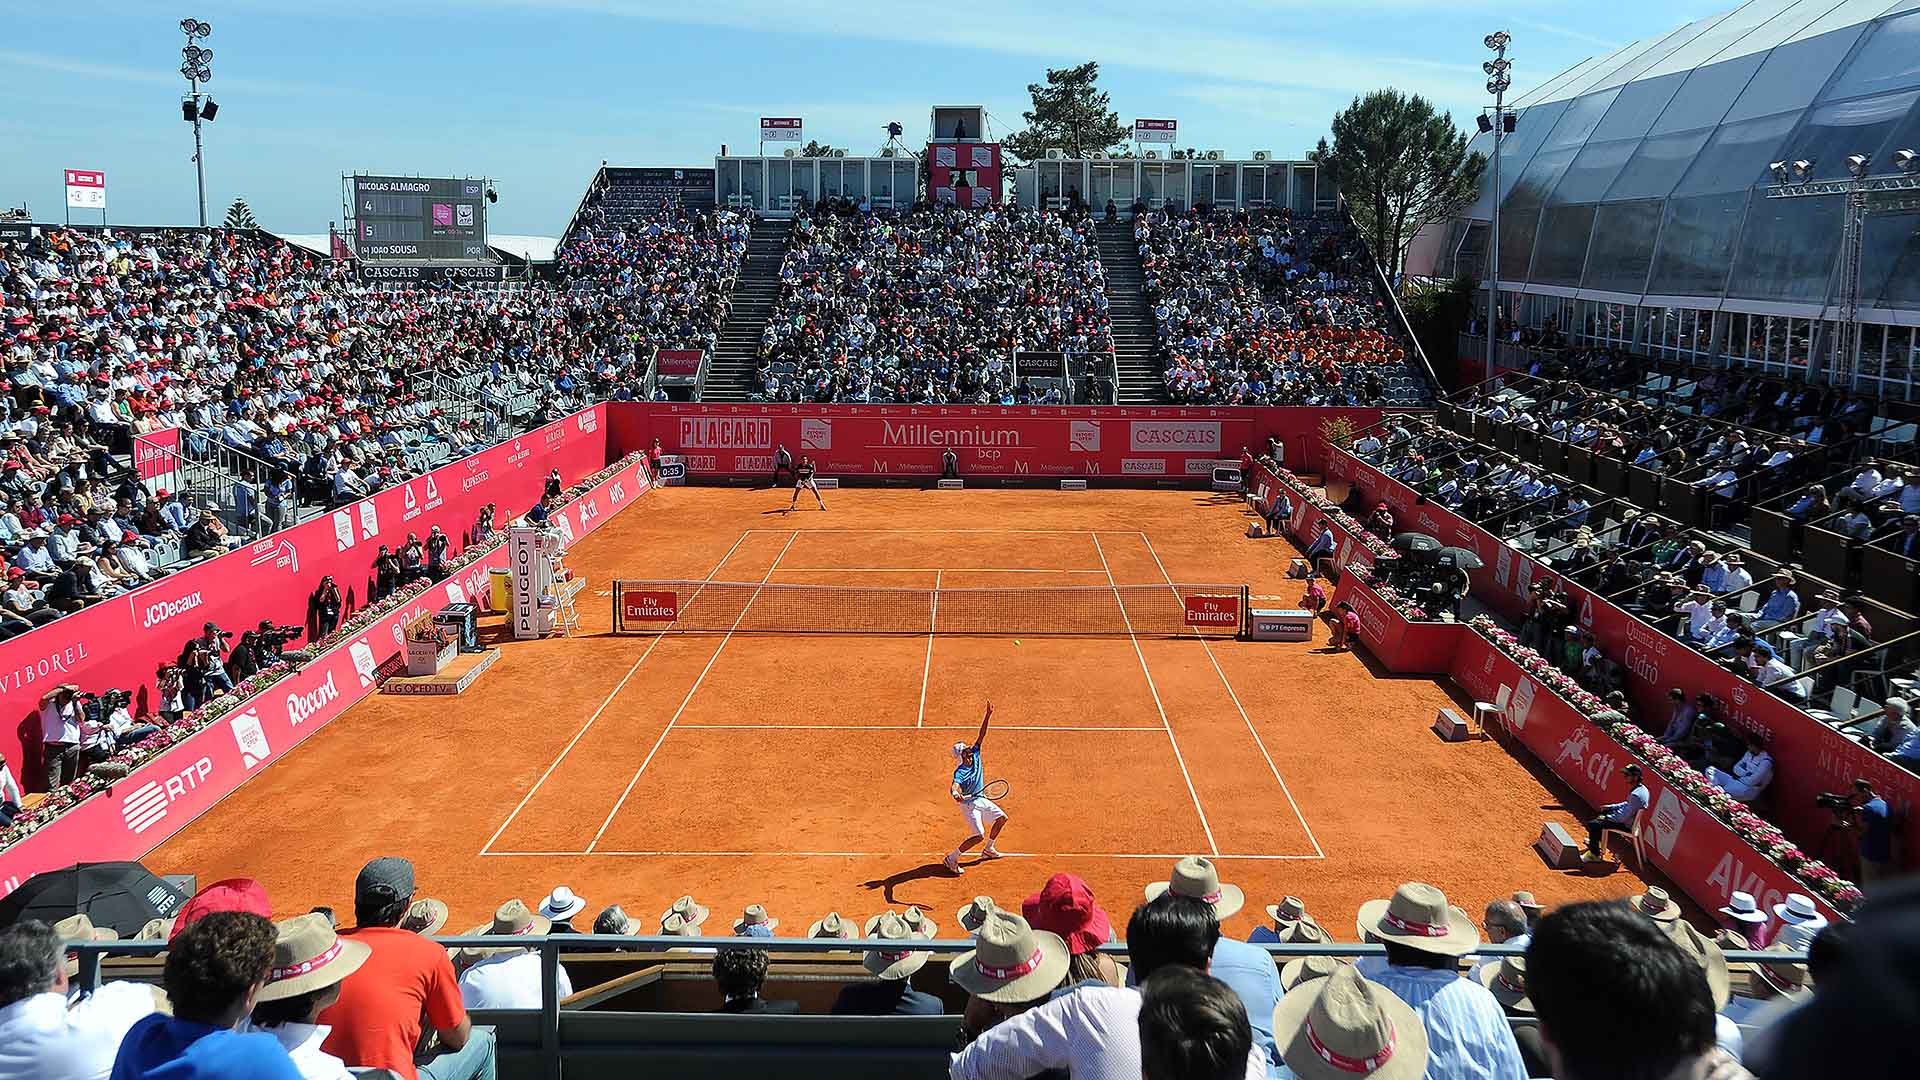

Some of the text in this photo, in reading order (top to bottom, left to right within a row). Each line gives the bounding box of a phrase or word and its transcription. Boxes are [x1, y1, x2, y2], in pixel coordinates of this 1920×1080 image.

[358, 182, 430, 192] NICOLAS ALMAGRO
[466, 186, 479, 194] ESP
[365, 200, 372, 211] 4
[366, 226, 373, 236] 5
[390, 245, 418, 254] SOUSA
[364, 267, 420, 278] CASCAIS
[445, 267, 496, 277] CASCAIS
[1018, 359, 1059, 367] CASCAIS
[680, 417, 772, 448] PLACARD
[881, 418, 1020, 446] Millennium
[1135, 429, 1216, 444] CASCAIS
[977, 447, 1001, 461] bcp
[735, 455, 776, 471] PLACAR
[1123, 461, 1164, 471] CASCAIS
[662, 466, 680, 477] 0:35
[608, 481, 625, 505] AVIS
[517, 536, 531, 632] PEUGEOT
[643, 597, 658, 607] Fly
[1204, 602, 1218, 612] Fly
[143, 591, 204, 629] JCDecaux
[627, 605, 674, 617] Emirates
[1187, 610, 1235, 622] Emirates
[1625, 619, 1668, 657] Quinta de
[0, 641, 89, 695] VIBOREL
[1624, 645, 1659, 686] Cidrô
[388, 684, 401, 693] LG
[433, 684, 447, 693] TV
[286, 669, 339, 728] Record
[165, 755, 213, 801] RTP
[1586, 752, 1615, 791] ctt
[156, 894, 176, 915] RTP
